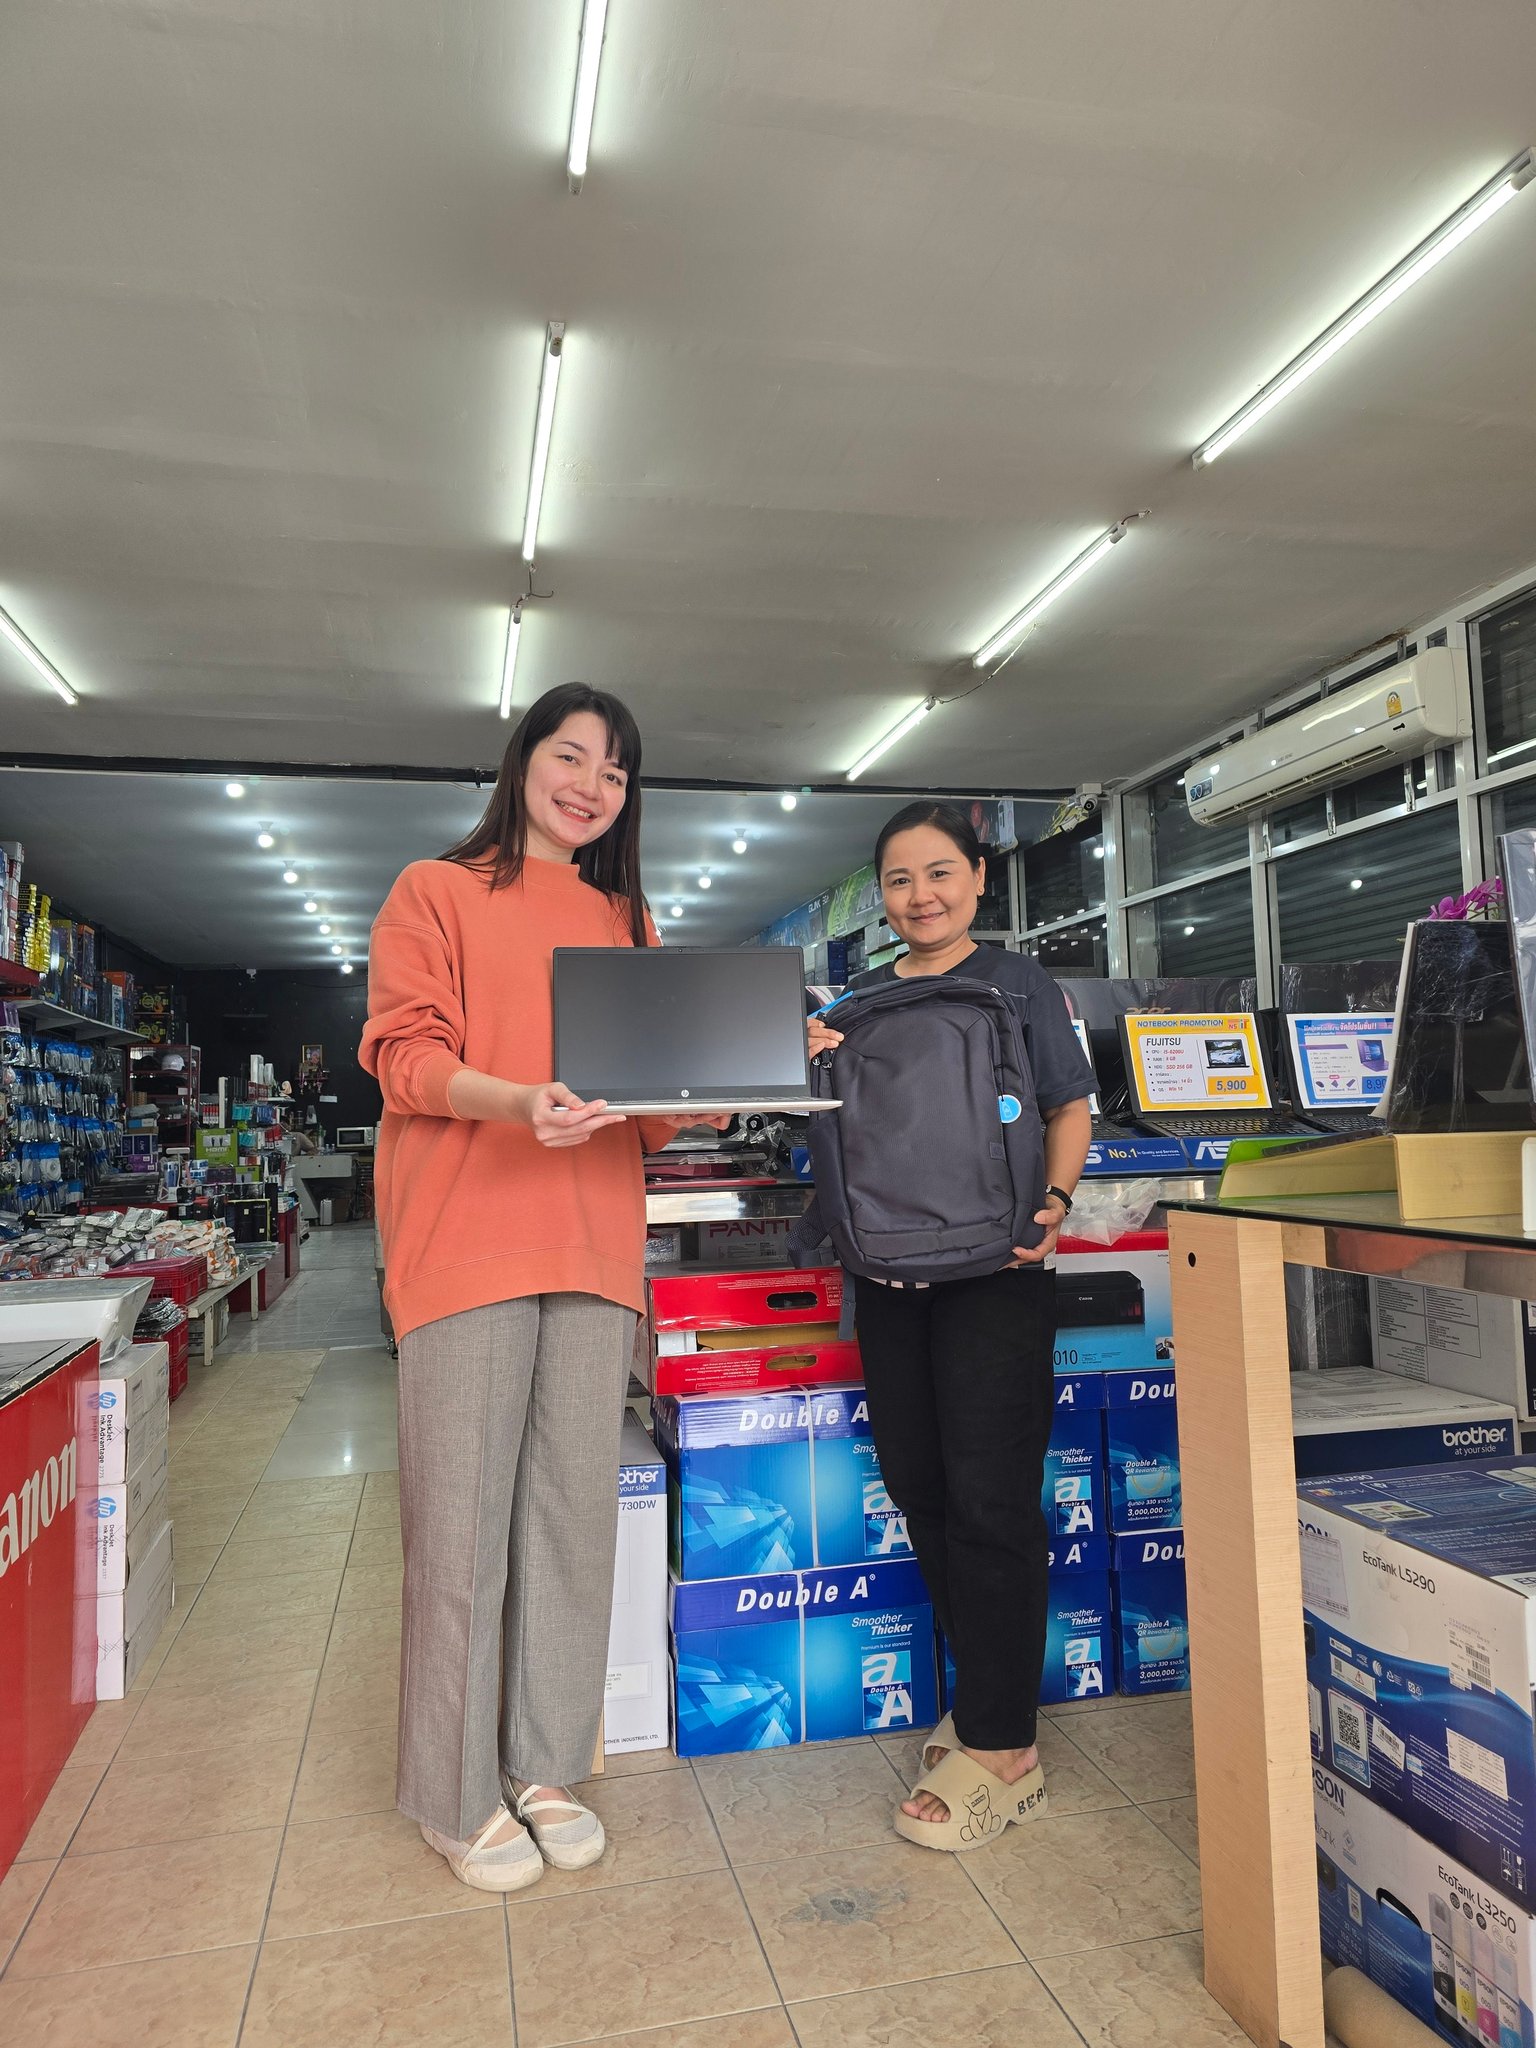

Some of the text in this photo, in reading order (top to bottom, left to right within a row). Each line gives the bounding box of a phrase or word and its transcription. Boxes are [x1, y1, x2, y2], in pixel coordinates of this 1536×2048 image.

[1137, 1019, 1224, 1028] NOTEBOOK PROMOTION
[1146, 1037, 1181, 1046] FUJITSU
[1216, 1080, 1247, 1092] 5,900
[1108, 1148, 1138, 1159] No.1
[1053, 1349, 1078, 1366] 010
[1057, 1384, 1075, 1404] A
[739, 1400, 870, 1432] Double A
[1442, 1426, 1507, 1447] brother
[852, 1443, 876, 1455] Smo
[1046, 1447, 1085, 1458] Smoother
[1454, 1444, 1497, 1457] at your side
[1061, 1455, 1092, 1464] Thicker
[1125, 1459, 1158, 1468] Double A
[620, 1484, 649, 1494] your side
[871, 1512, 896, 1520] Double
[1066, 1504, 1093, 1533] A
[1127, 1506, 1164, 1517] 3,000,000
[879, 1516, 914, 1553] A
[1065, 1543, 1082, 1565] A
[1362, 1550, 1436, 1594] EcoTank L5290
[736, 1576, 869, 1613] Double A
[851, 1613, 903, 1628] Smoother
[1057, 1609, 1095, 1620] Smoother
[1071, 1616, 1103, 1626] Thicker
[871, 1622, 913, 1636] Thicker
[1137, 1619, 1170, 1630] Double A
[1139, 1668, 1175, 1679] 3,000,000
[1075, 1667, 1103, 1696] A
[870, 1686, 895, 1694] Double
[878, 1689, 913, 1726] A
[1438, 1864, 1517, 1934] EcoTank L3250
[1434, 1942, 1450, 1960] EPSON
[1455, 1960, 1472, 1978] EPSON
[1476, 1978, 1494, 1996] EPSON
[1499, 1996, 1517, 2016] EPSON
